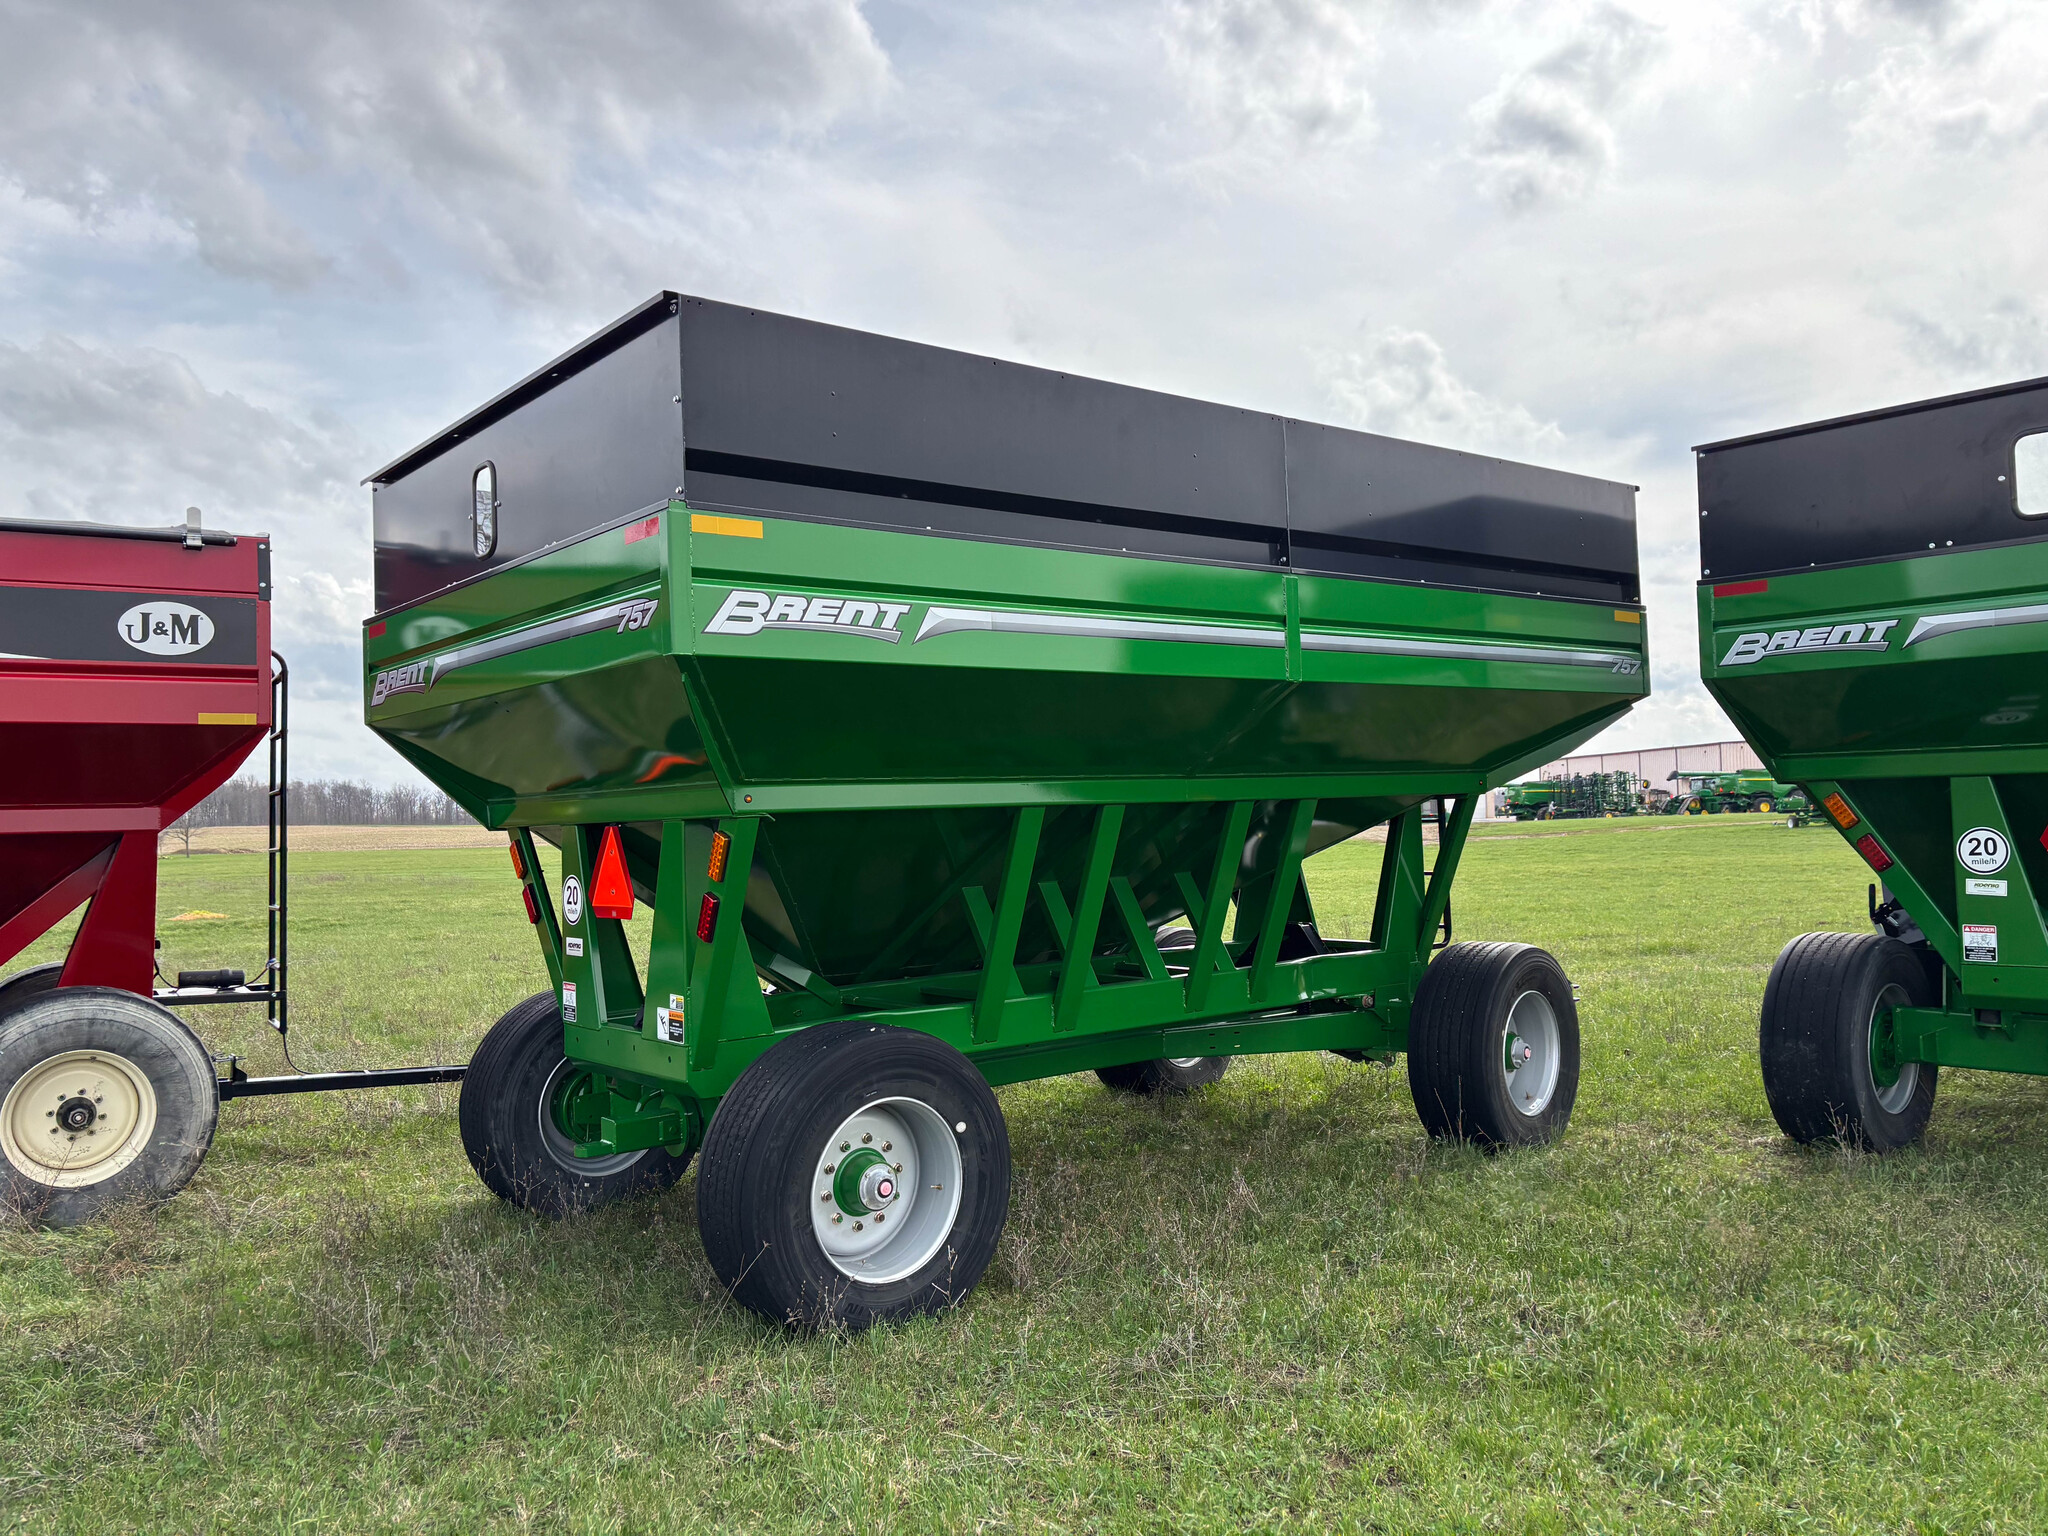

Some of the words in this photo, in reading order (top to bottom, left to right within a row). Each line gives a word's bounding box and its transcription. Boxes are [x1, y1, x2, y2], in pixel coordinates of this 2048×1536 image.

[125, 611, 201, 645] J&M
[617, 598, 660, 635] 757
[700, 588, 913, 638] BRENT
[1718, 618, 1902, 667] BRENT
[371, 659, 429, 707] BRENT
[1611, 657, 1642, 675] 757
[1967, 837, 1998, 856] 20
[566, 885, 579, 906] 20
